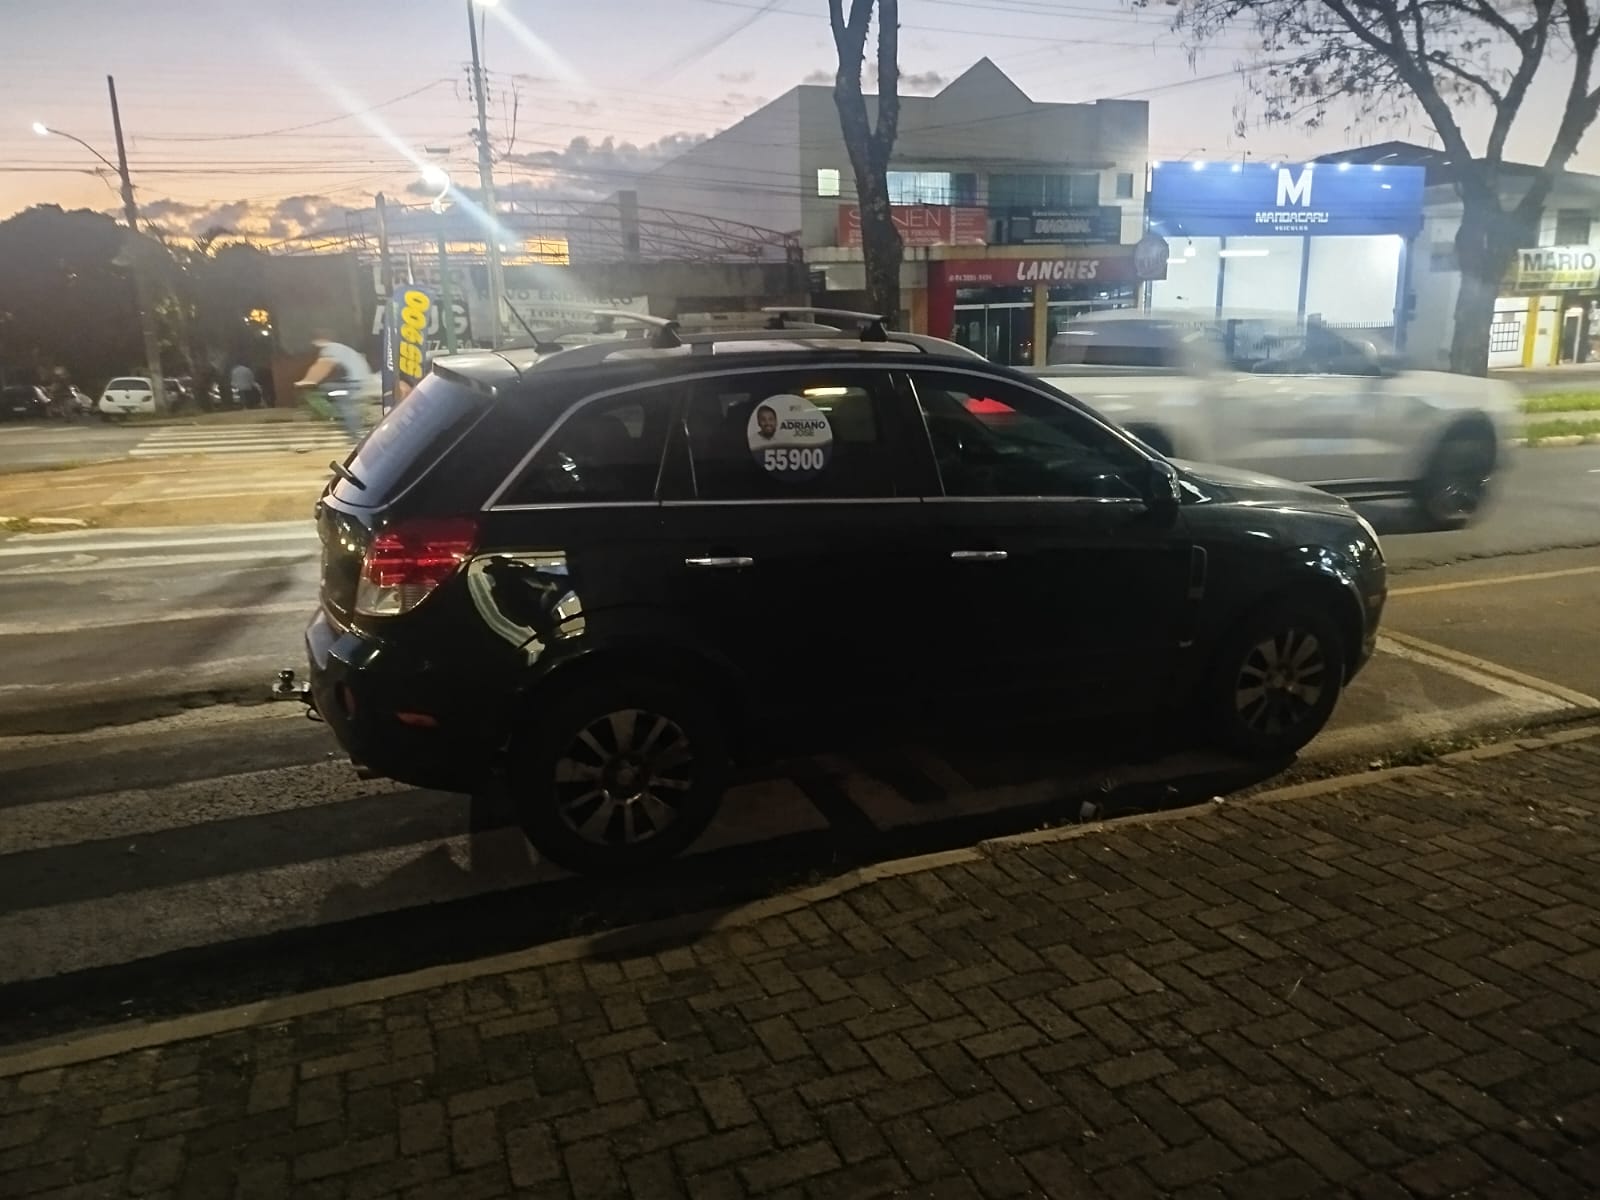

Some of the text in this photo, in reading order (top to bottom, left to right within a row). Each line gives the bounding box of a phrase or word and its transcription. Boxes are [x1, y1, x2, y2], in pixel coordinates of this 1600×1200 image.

[1016, 259, 1100, 281] LANCHES
[398, 289, 431, 379] 55900
[780, 420, 826, 430] ADRIANO
[764, 447, 825, 471] 55900
